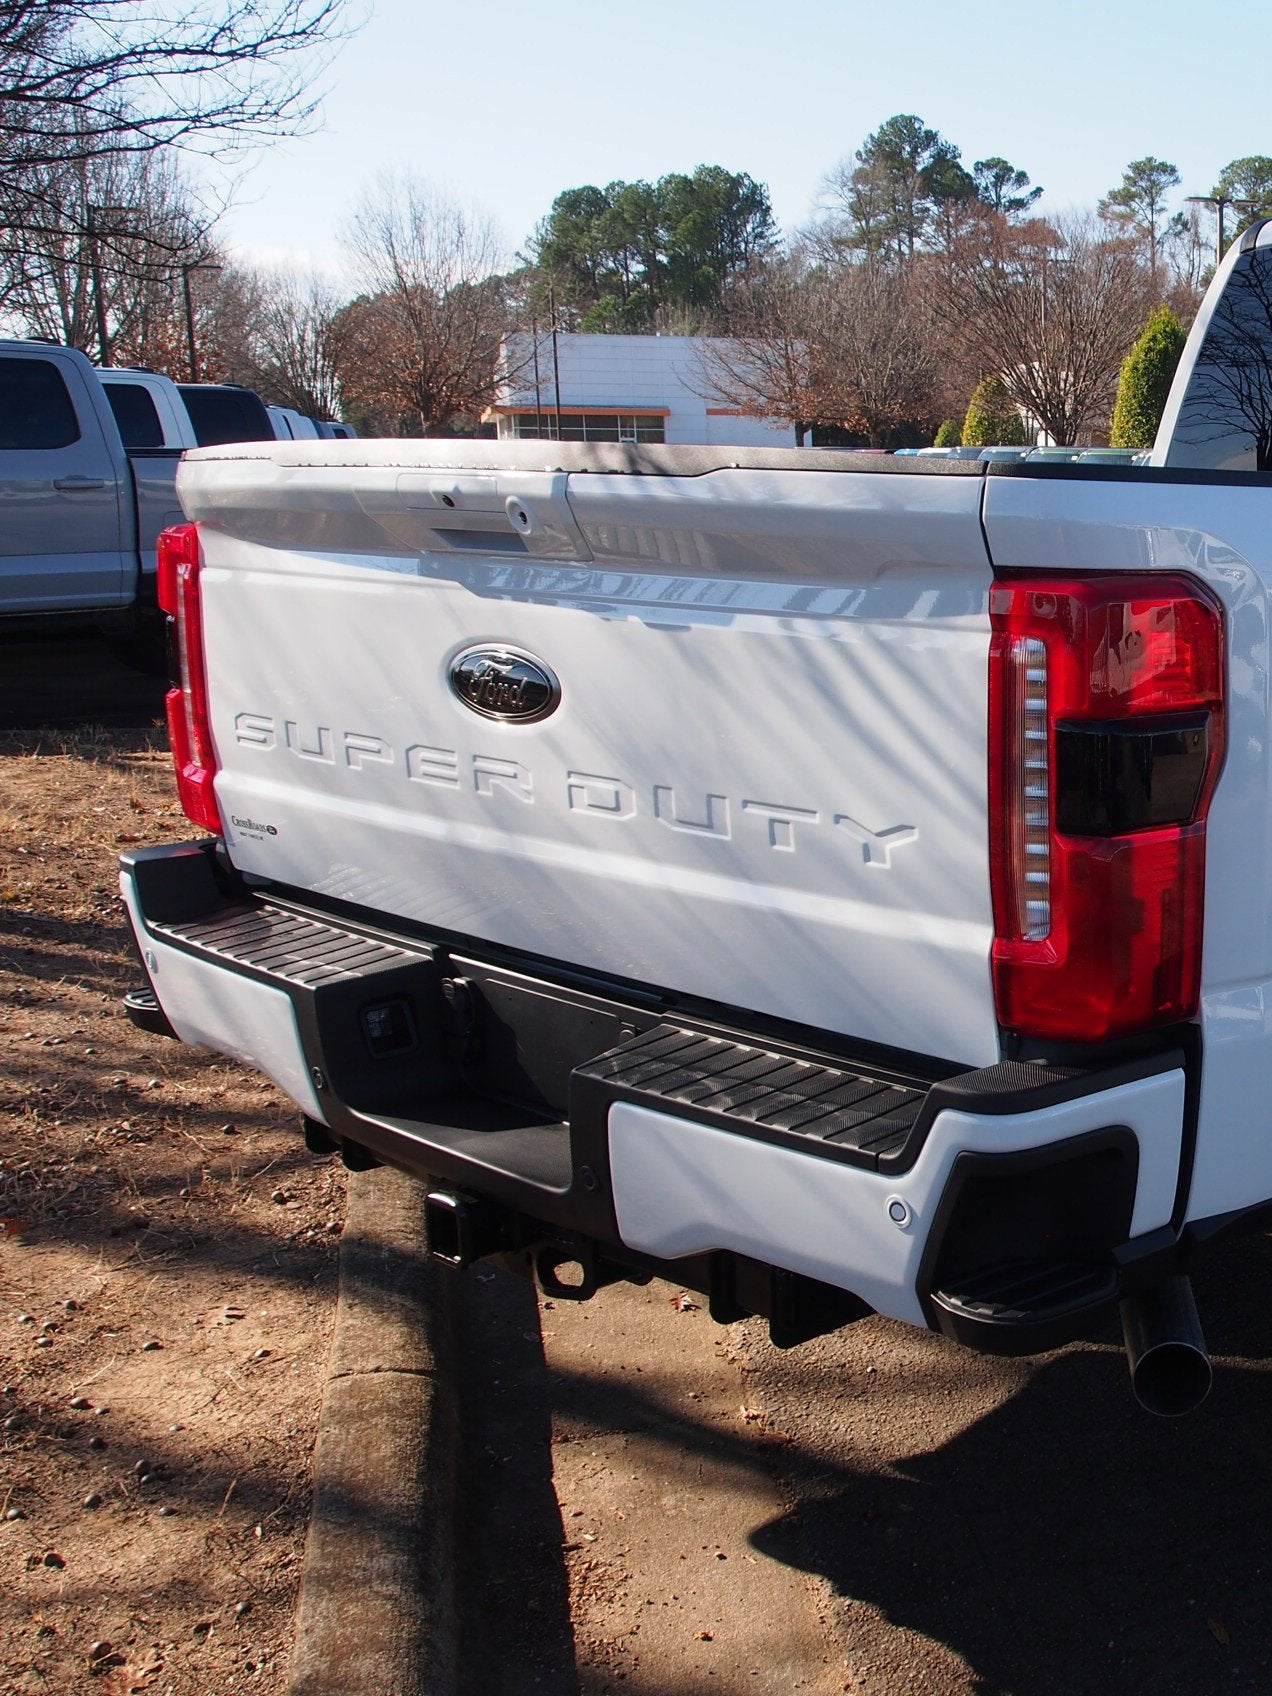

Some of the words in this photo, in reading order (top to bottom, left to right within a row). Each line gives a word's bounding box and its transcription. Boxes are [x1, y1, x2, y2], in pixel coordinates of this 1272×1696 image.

[469, 658, 528, 707] Ford
[235, 712, 534, 803] SUPER
[567, 770, 919, 869] DUTY
